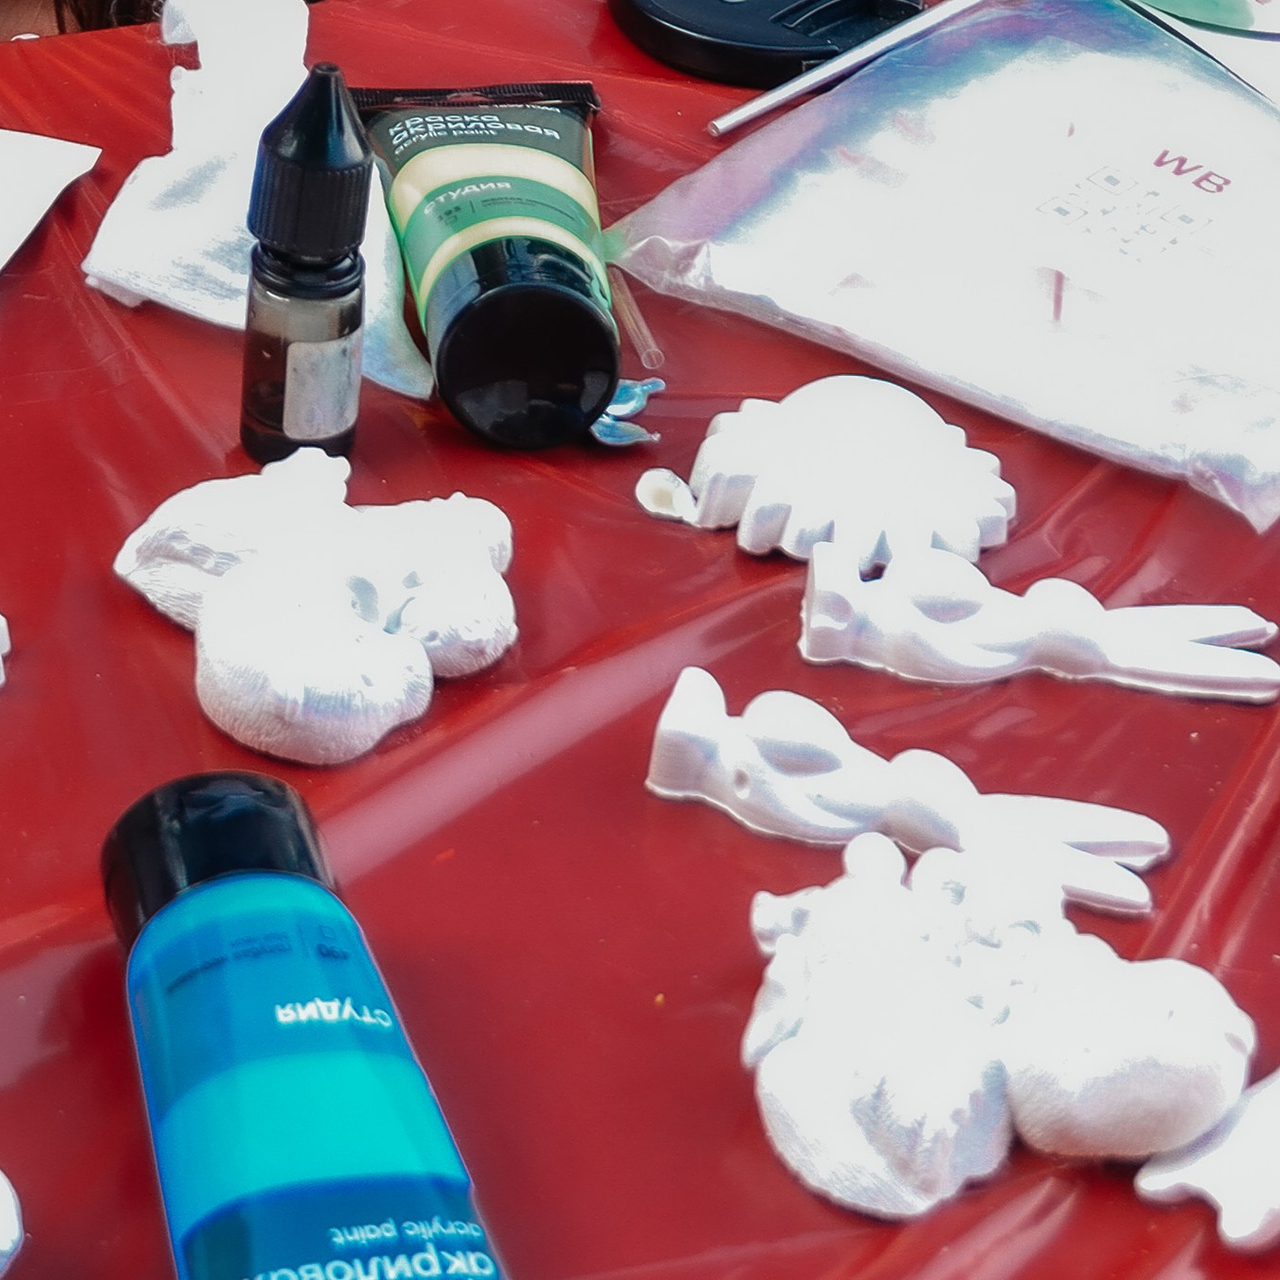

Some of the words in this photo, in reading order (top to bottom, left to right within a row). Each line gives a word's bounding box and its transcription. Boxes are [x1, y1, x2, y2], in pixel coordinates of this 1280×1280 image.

[389, 114, 500, 136] краска
[391, 121, 561, 145] акриловая
[394, 129, 448, 155] acrylic
[452, 128, 498, 137] paint
[1153, 149, 1232, 194] WB
[423, 181, 513, 215] студия
[275, 996, 394, 1029] студия
[327, 1217, 399, 1245] paint
[401, 1215, 483, 1239] acrylic
[243, 1241, 497, 1280] акрилова
